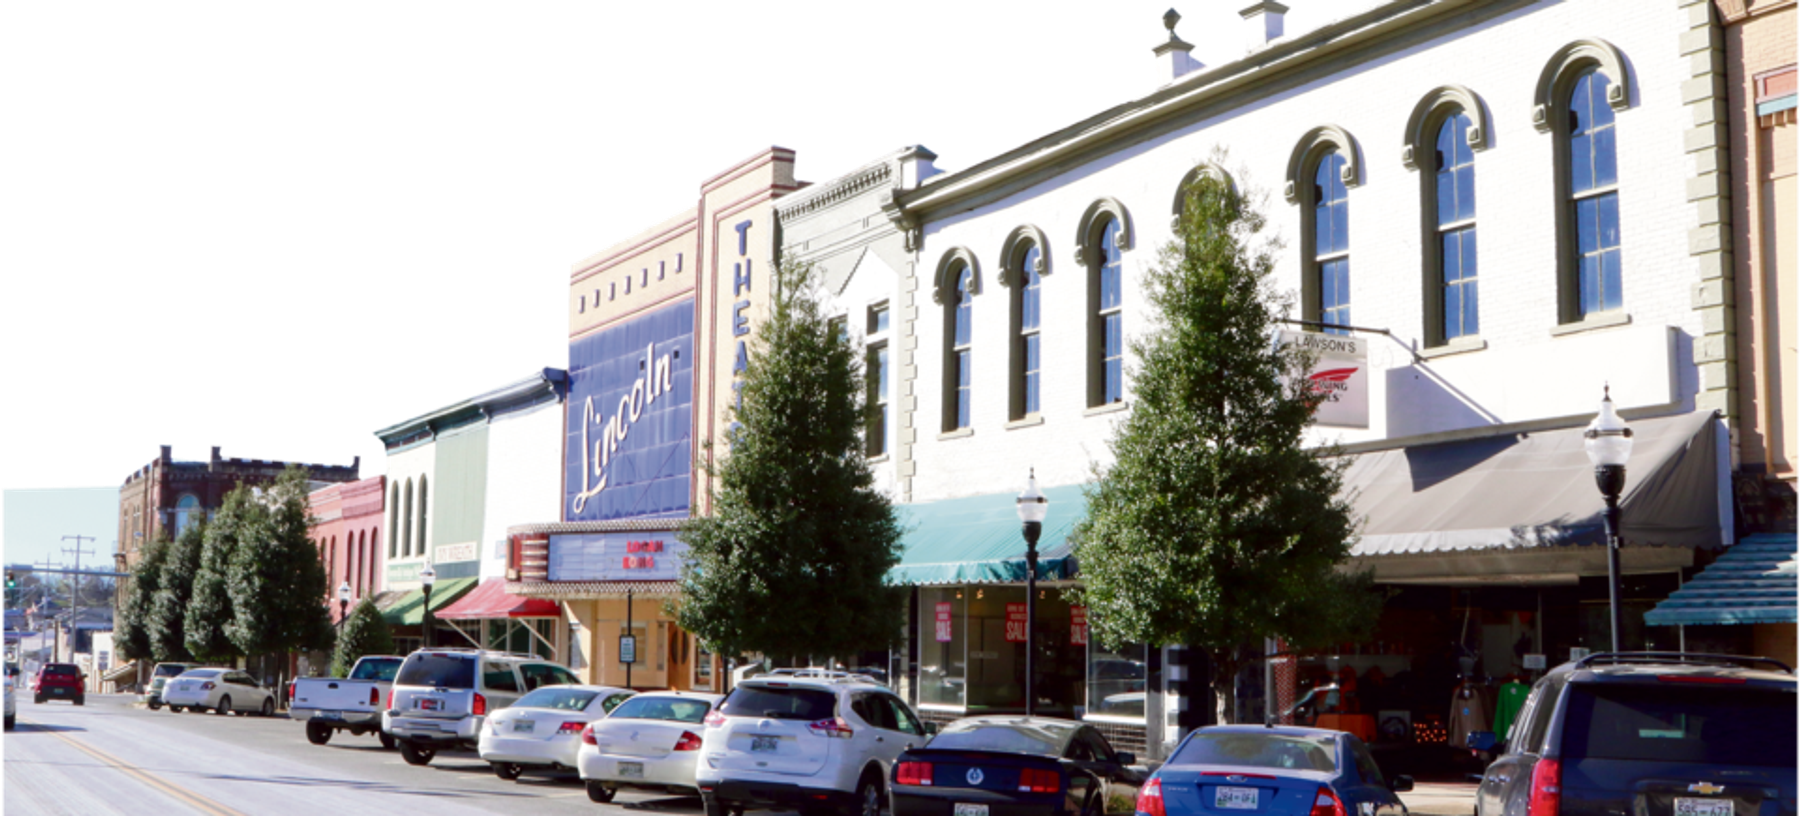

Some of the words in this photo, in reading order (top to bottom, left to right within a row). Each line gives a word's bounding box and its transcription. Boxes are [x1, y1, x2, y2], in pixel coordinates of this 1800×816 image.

[731, 219, 753, 454] THEATR
[1295, 336, 1357, 354] LAWSON'S
[574, 342, 672, 513] Lincoln
[626, 540, 663, 553] LOGAN
[935, 620, 951, 641] SALE
[1006, 620, 1028, 640] SAL
